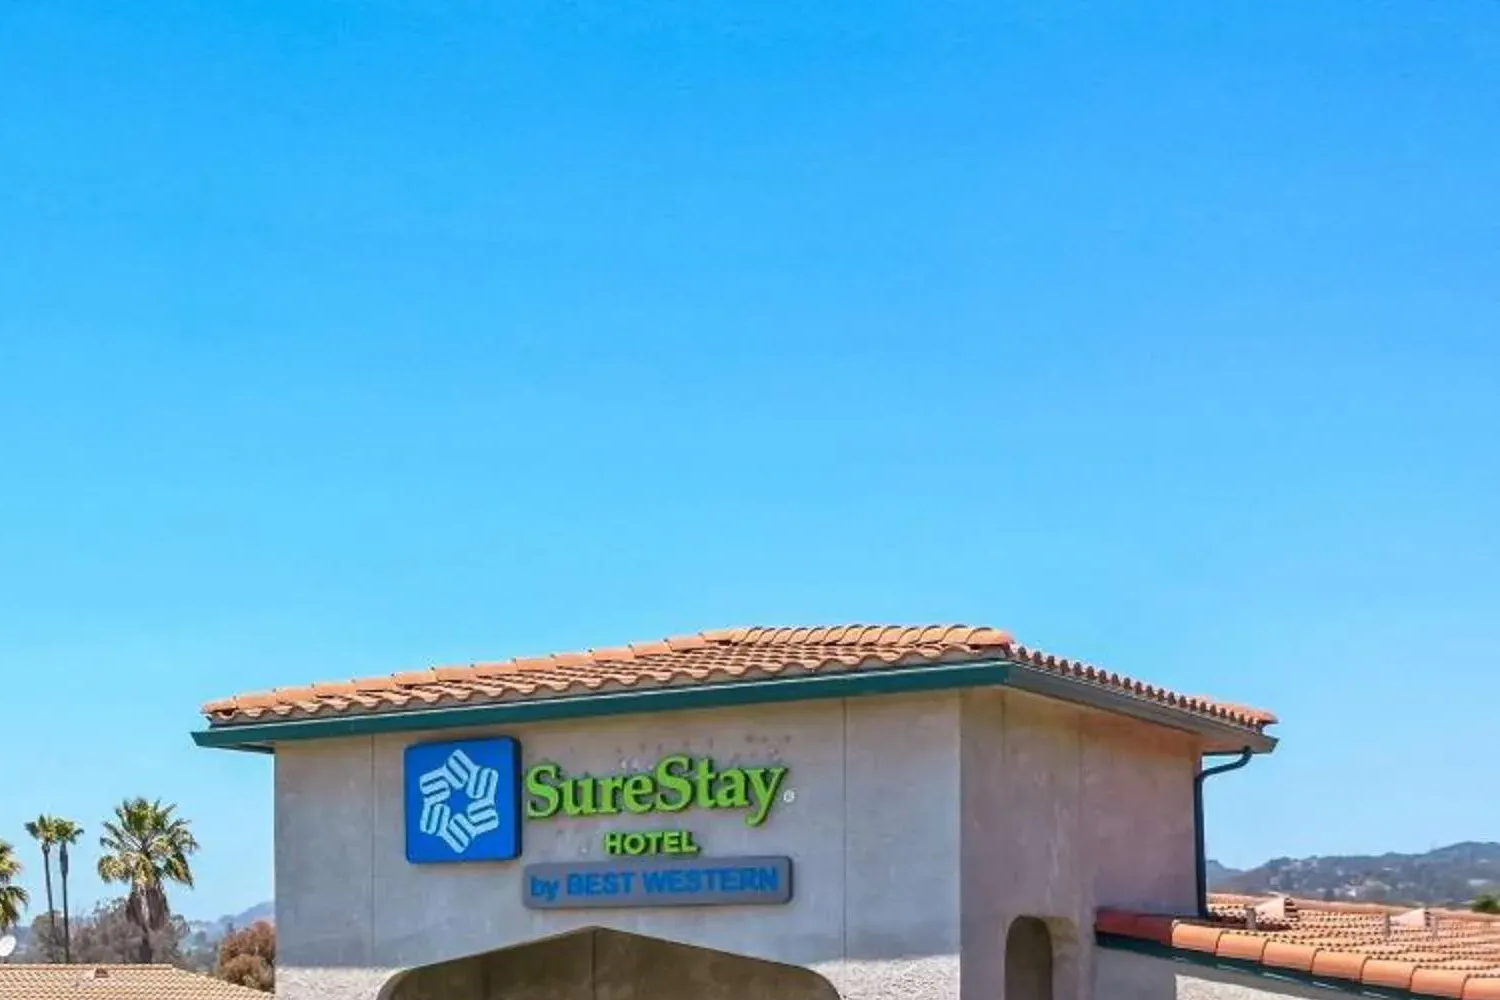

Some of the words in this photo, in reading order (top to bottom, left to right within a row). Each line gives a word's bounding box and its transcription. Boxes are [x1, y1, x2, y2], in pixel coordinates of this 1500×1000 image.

[525, 754, 787, 827] SureStay
[605, 831, 700, 855] HOTEL
[531, 875, 559, 900] by
[567, 871, 634, 896] BEST
[642, 866, 779, 894] WESTERN
